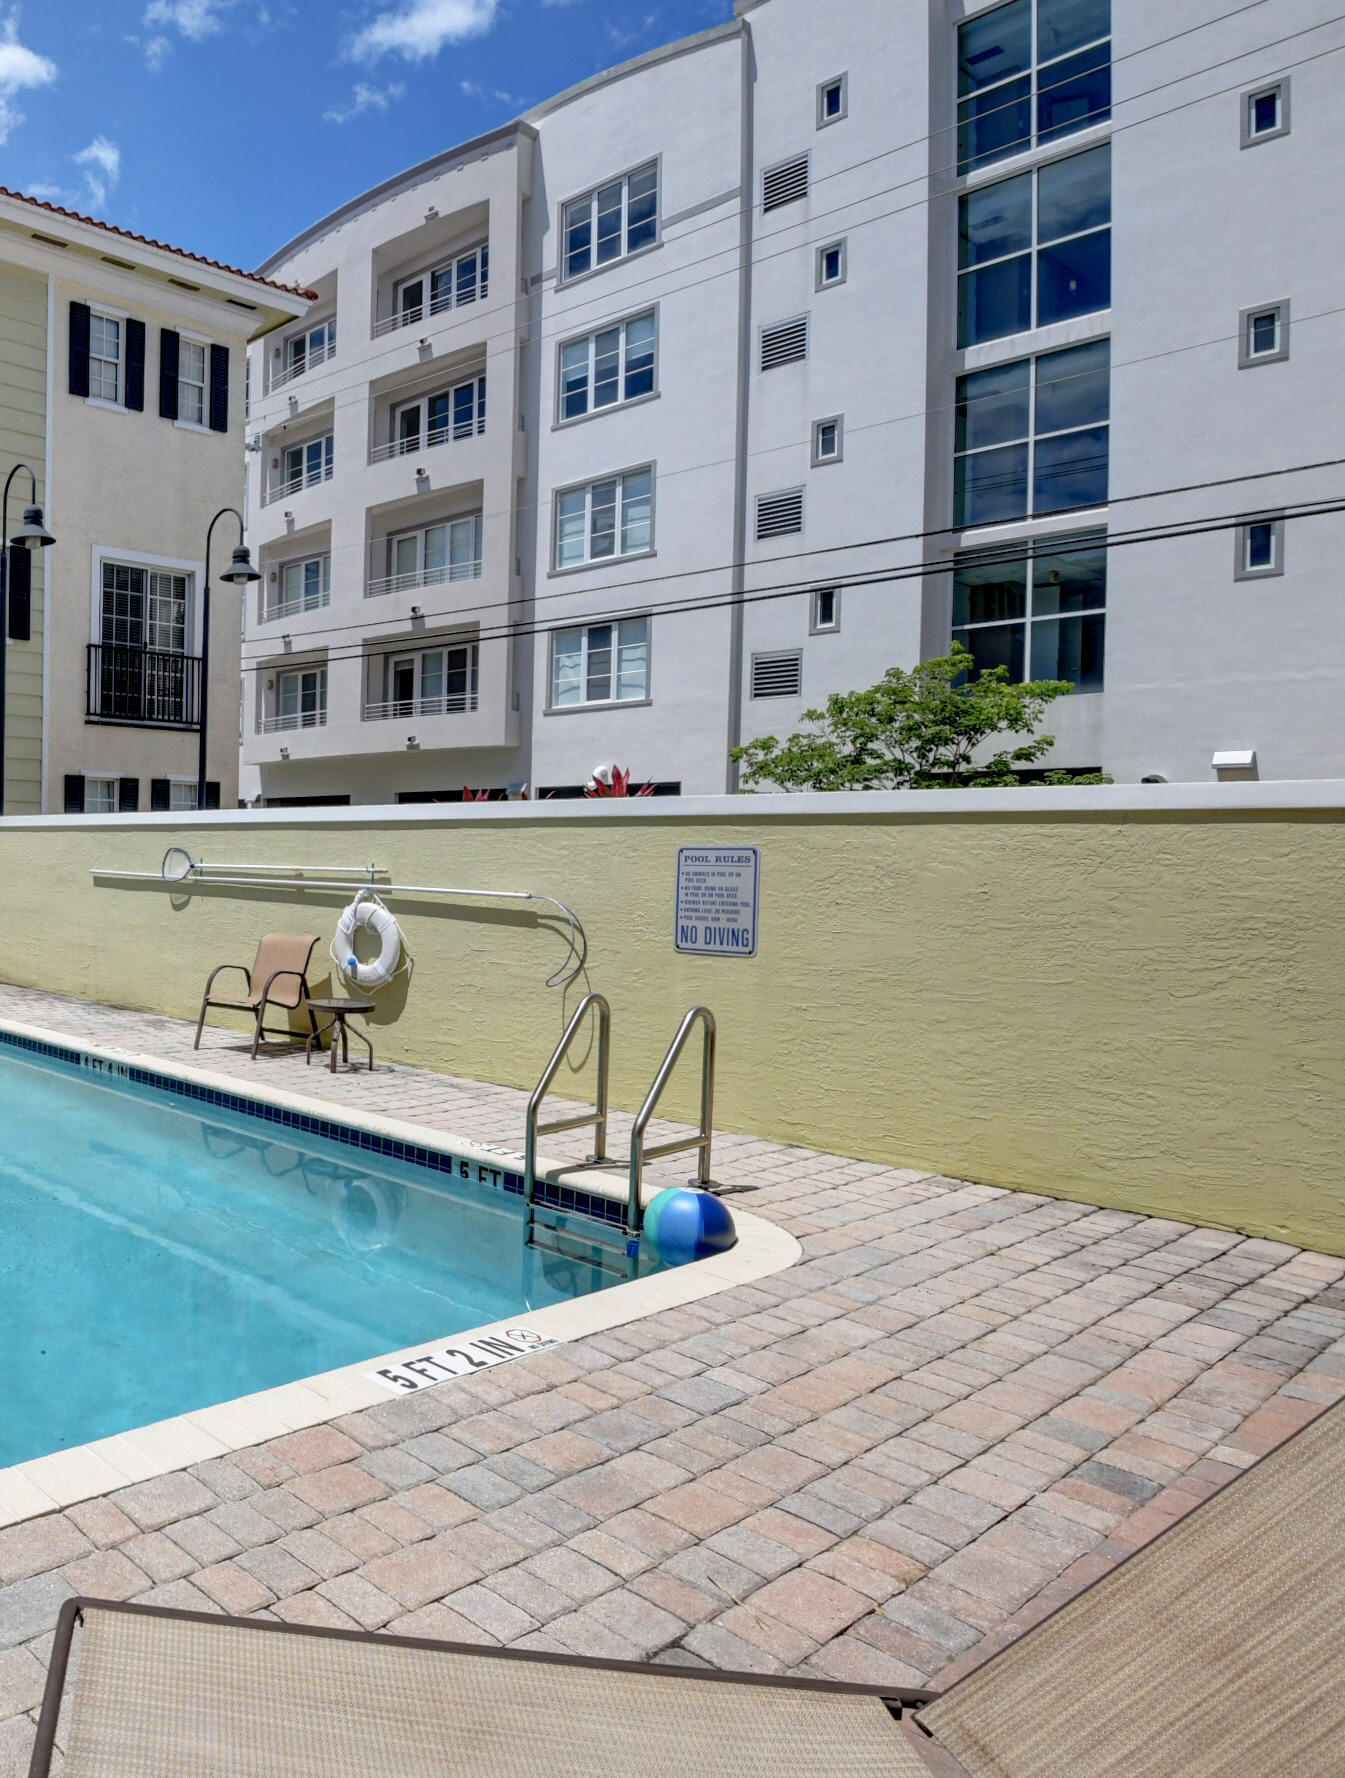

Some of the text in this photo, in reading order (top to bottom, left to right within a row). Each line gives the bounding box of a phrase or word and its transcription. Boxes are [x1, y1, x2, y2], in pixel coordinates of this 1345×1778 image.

[684, 855, 751, 864] POOL RULES
[680, 925, 749, 947] NO DIVING
[459, 1161, 501, 1187] 5 FT
[376, 1369, 418, 1389] 5
[401, 1356, 458, 1382] FT
[445, 1349, 488, 1368] 2
[469, 1336, 526, 1359] IN
